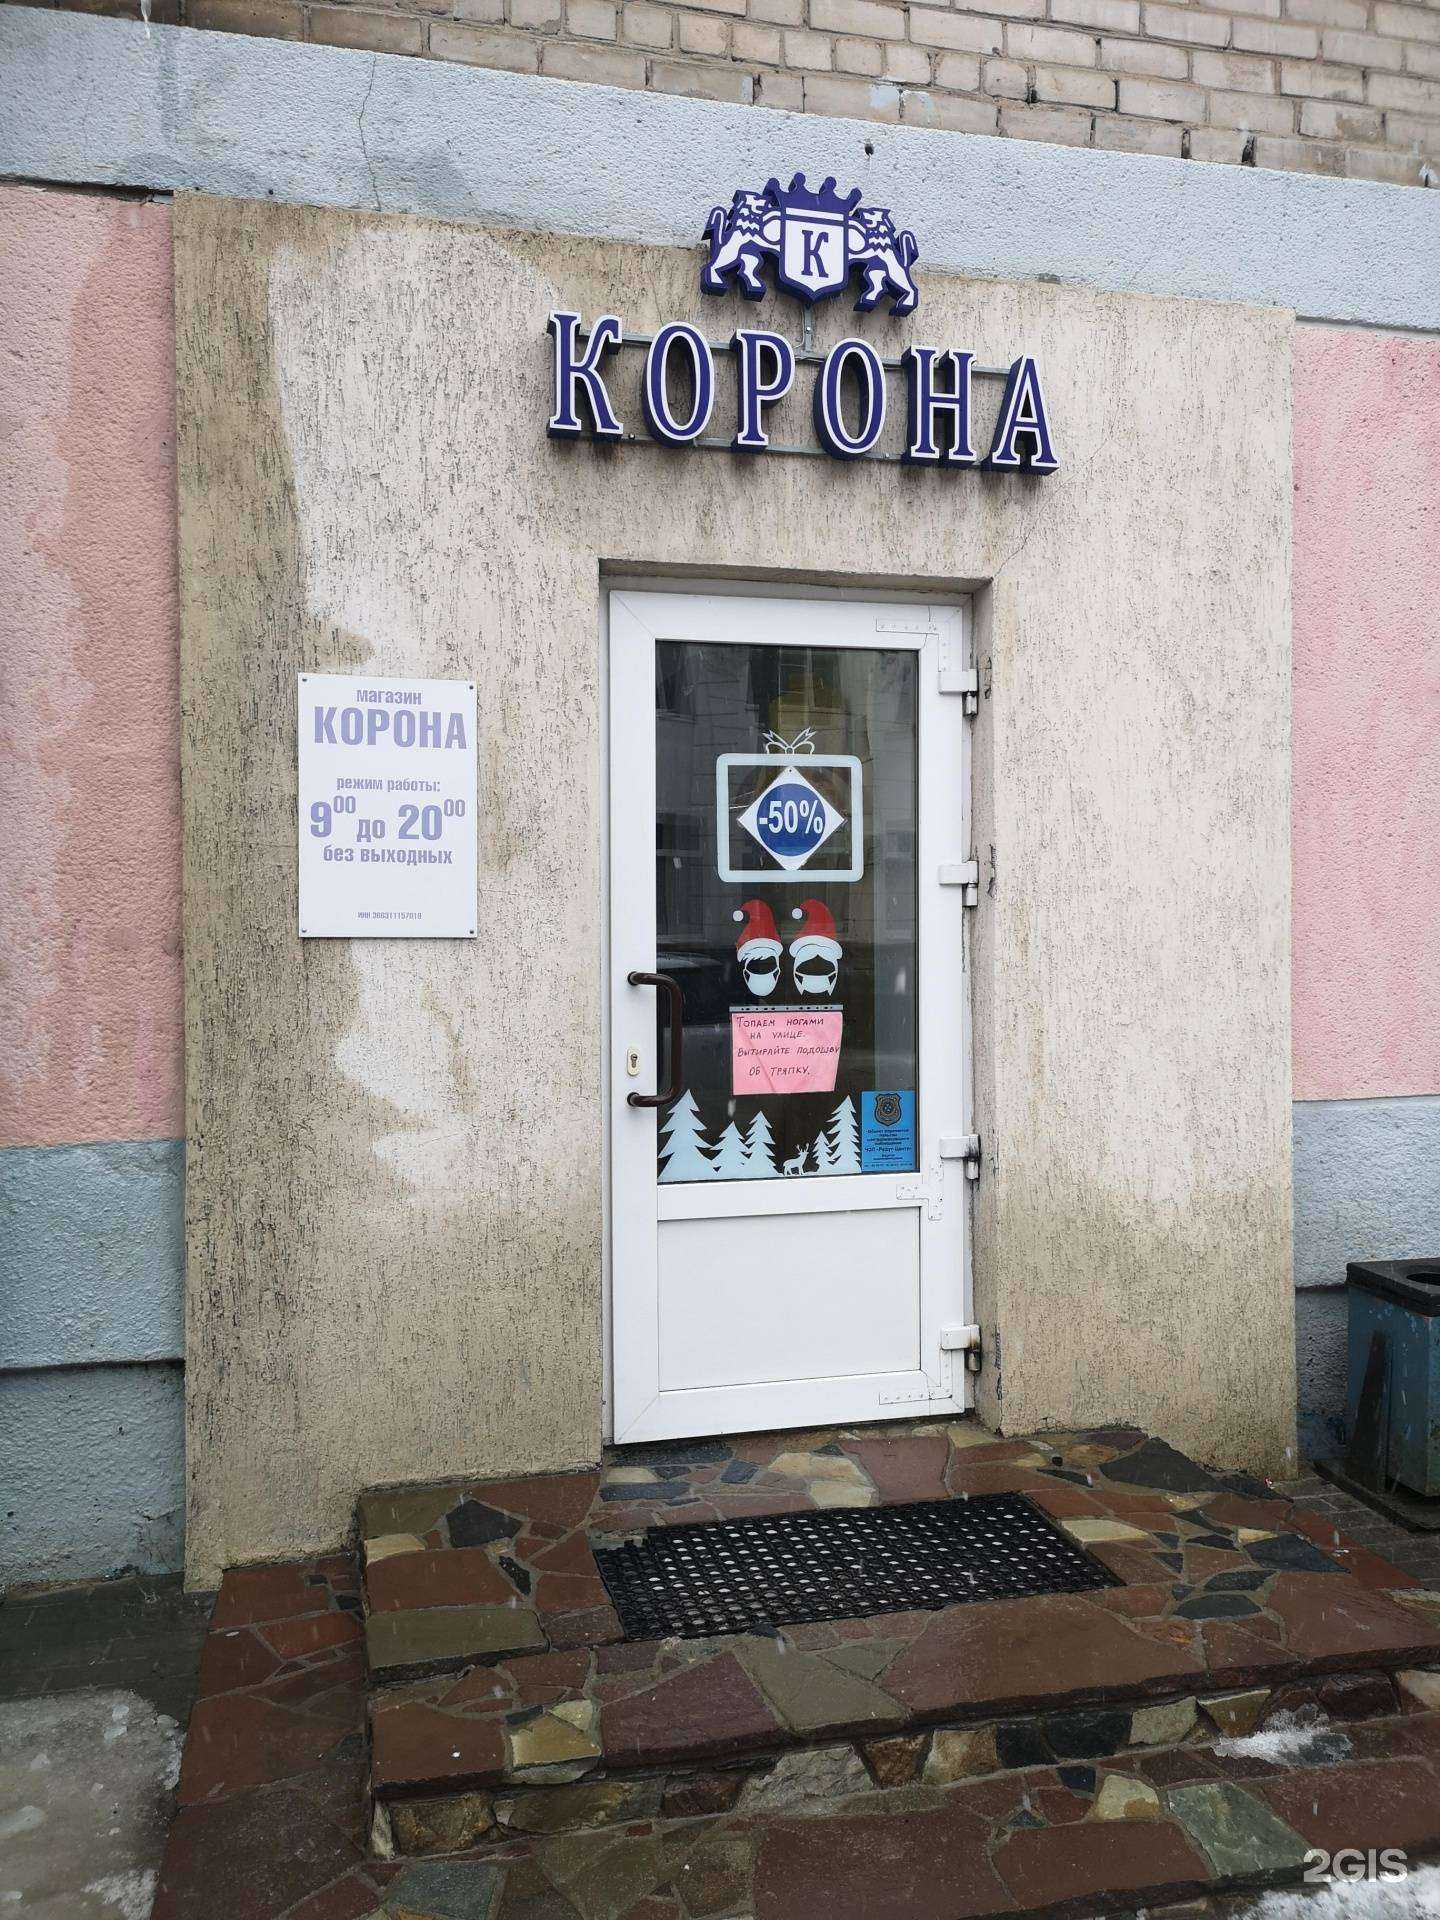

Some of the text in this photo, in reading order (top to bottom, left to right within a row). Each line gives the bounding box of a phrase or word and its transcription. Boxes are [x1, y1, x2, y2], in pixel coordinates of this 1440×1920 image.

[800, 229, 829, 278] К
[547, 310, 1060, 476] КОРОНА
[356, 689, 422, 705] магазин
[314, 706, 467, 750] КОРОНА
[336, 777, 441, 793] режим работы:
[356, 819, 386, 843] до
[759, 799, 823, 835] -50%
[323, 845, 453, 866] без выходных
